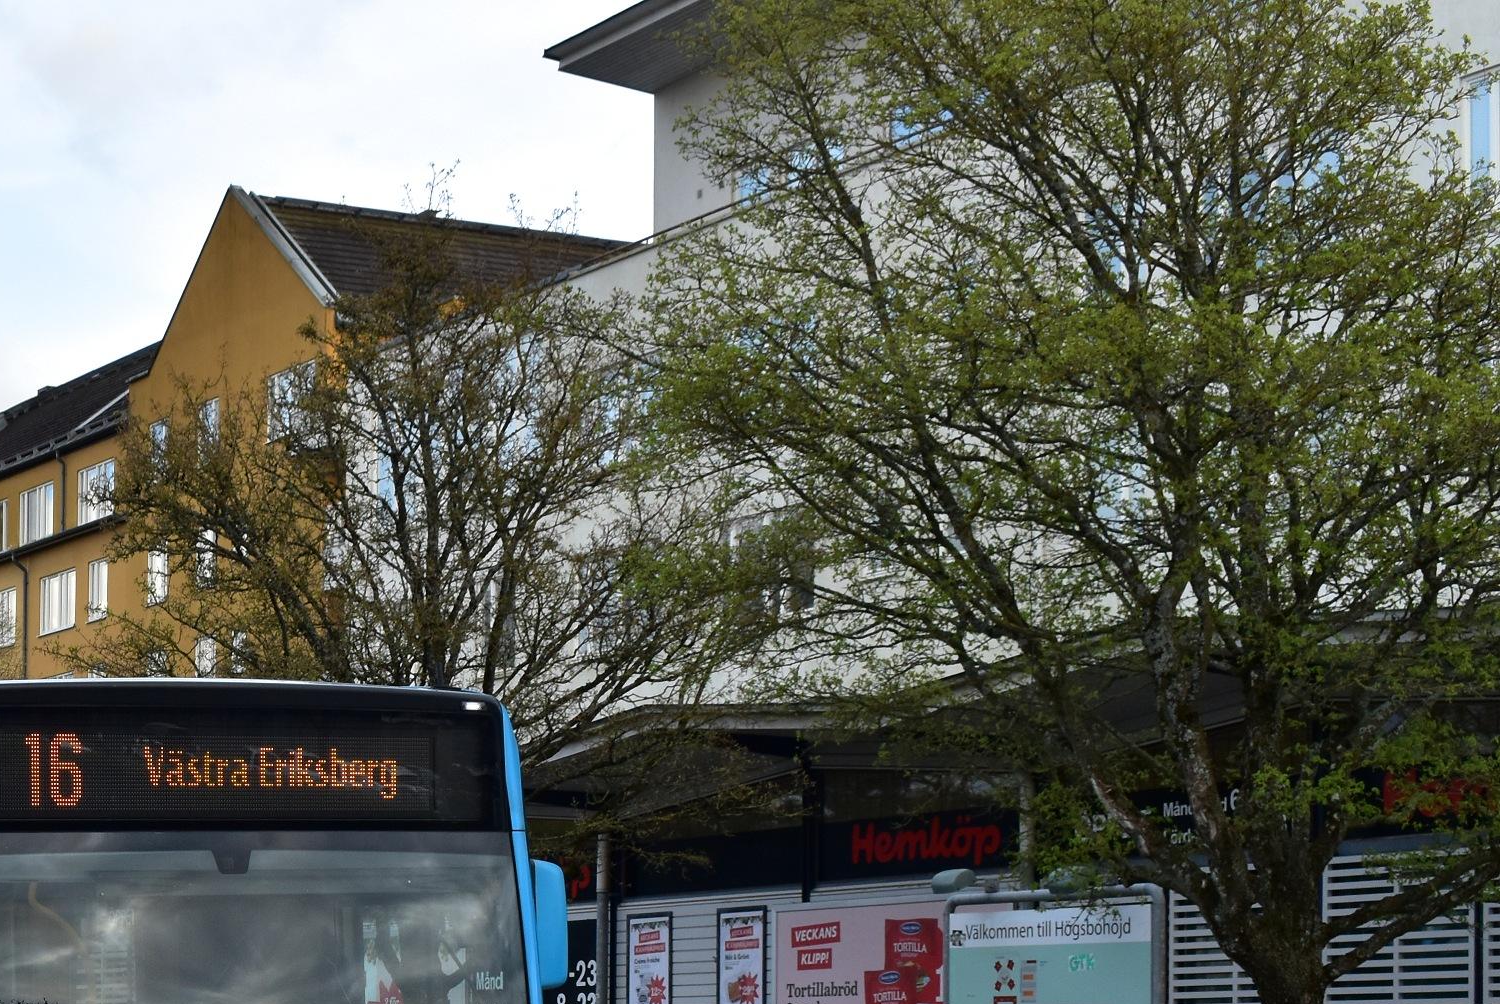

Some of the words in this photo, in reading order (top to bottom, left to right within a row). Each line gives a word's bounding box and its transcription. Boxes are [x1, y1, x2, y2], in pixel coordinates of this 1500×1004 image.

[25, 733, 83, 807] 16
[144, 745, 249, 788] Västra
[259, 746, 398, 799] Eriksberg
[851, 815, 1002, 868] Hemköp
[794, 925, 837, 943] VECKANS
[965, 923, 1034, 940] Välkommen
[1037, 922, 1052, 938] till
[1054, 917, 1132, 941] Högsbohöjd
[893, 941, 927, 953] TORTILLA
[801, 951, 829, 965] KLIPP!
[786, 980, 858, 998] Tortillabröd
[873, 991, 907, 1003] TORTILLA
